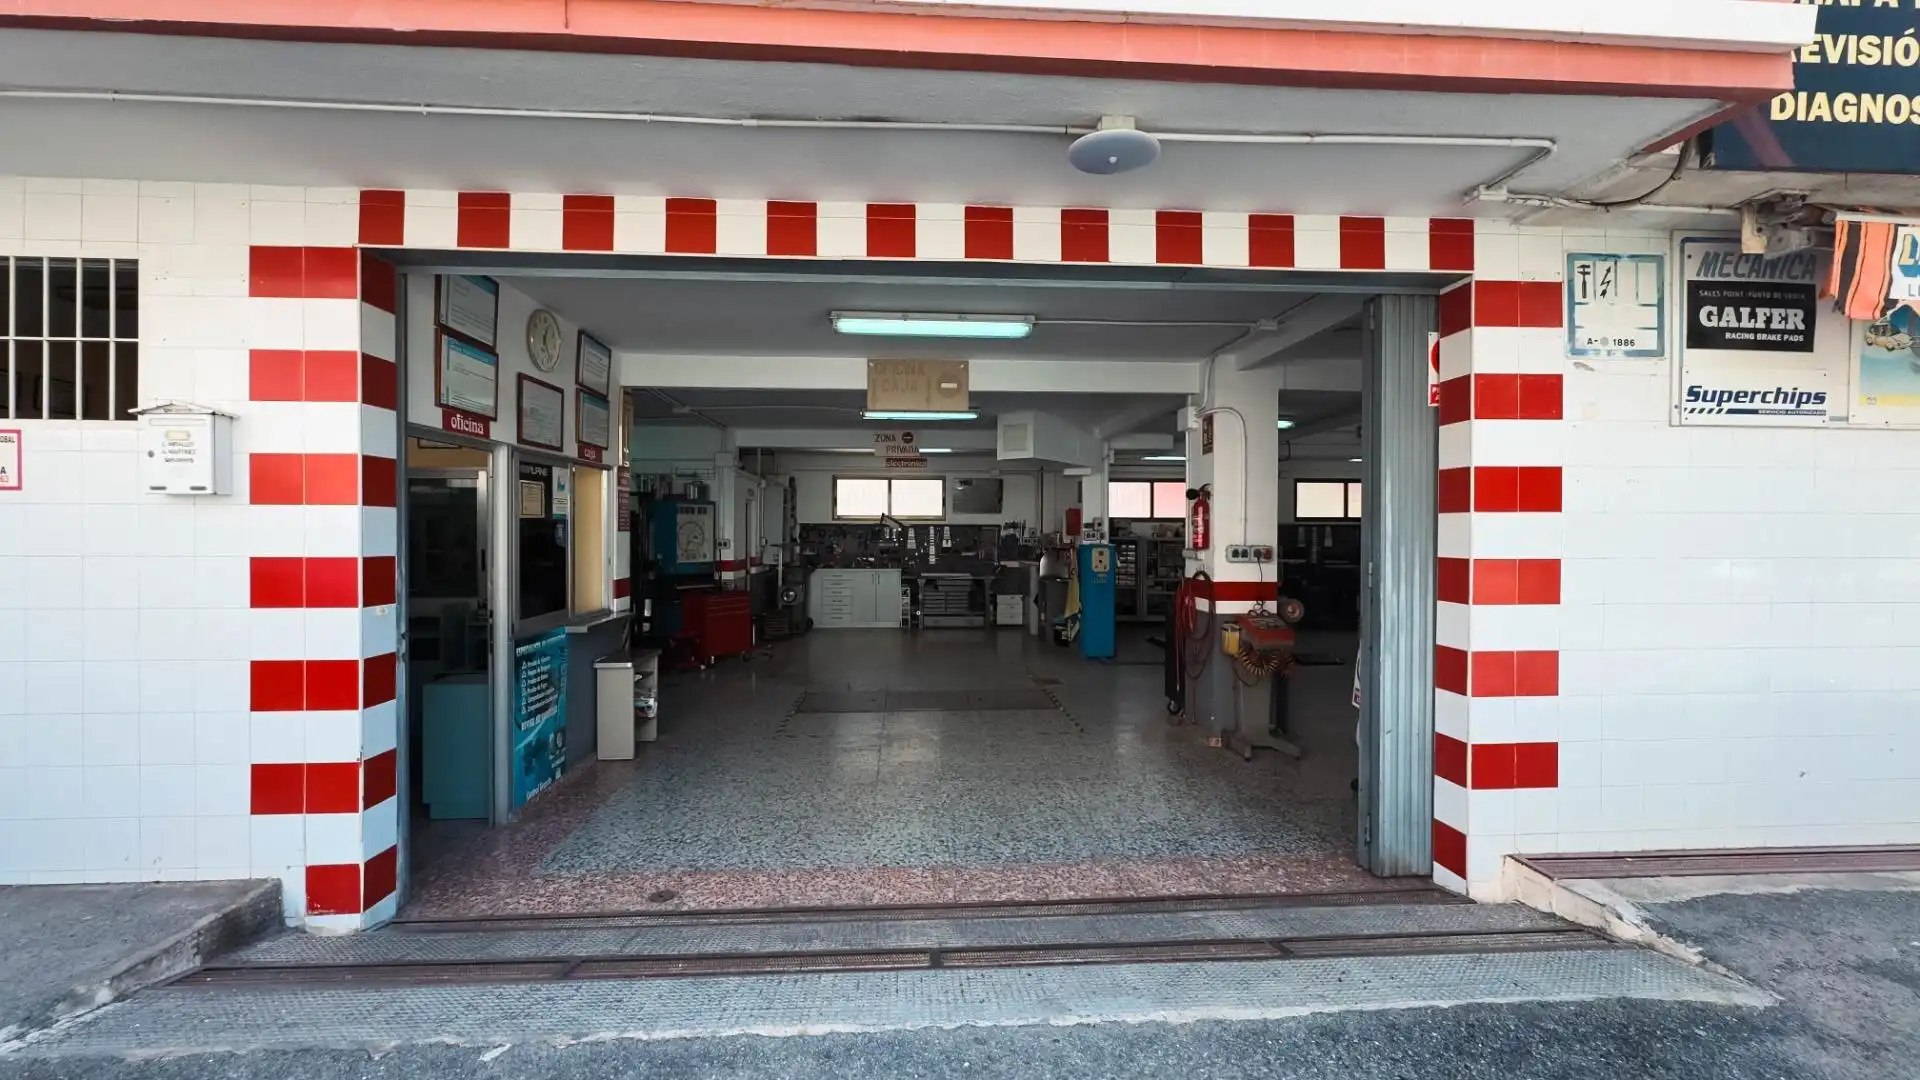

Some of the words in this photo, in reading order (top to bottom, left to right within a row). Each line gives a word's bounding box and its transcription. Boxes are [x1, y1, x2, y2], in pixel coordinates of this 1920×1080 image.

[1791, 28, 1920, 67] EVISIÓ
[1699, 290, 1721, 298] SALES
[1748, 291, 1771, 299] PUNTO
[1699, 305, 1806, 330] GALFER
[1612, 338, 1636, 346] 1886
[1725, 332, 1755, 340] RACING
[1757, 332, 1782, 341] BRAKE
[1783, 333, 1804, 342] PADS
[874, 362, 925, 377] OFICINA
[882, 377, 919, 393] CAJA
[1685, 385, 1827, 408] Superchips
[451, 414, 484, 435] oficina
[874, 433, 897, 443] ZONA
[886, 445, 920, 455] PRIVADA
